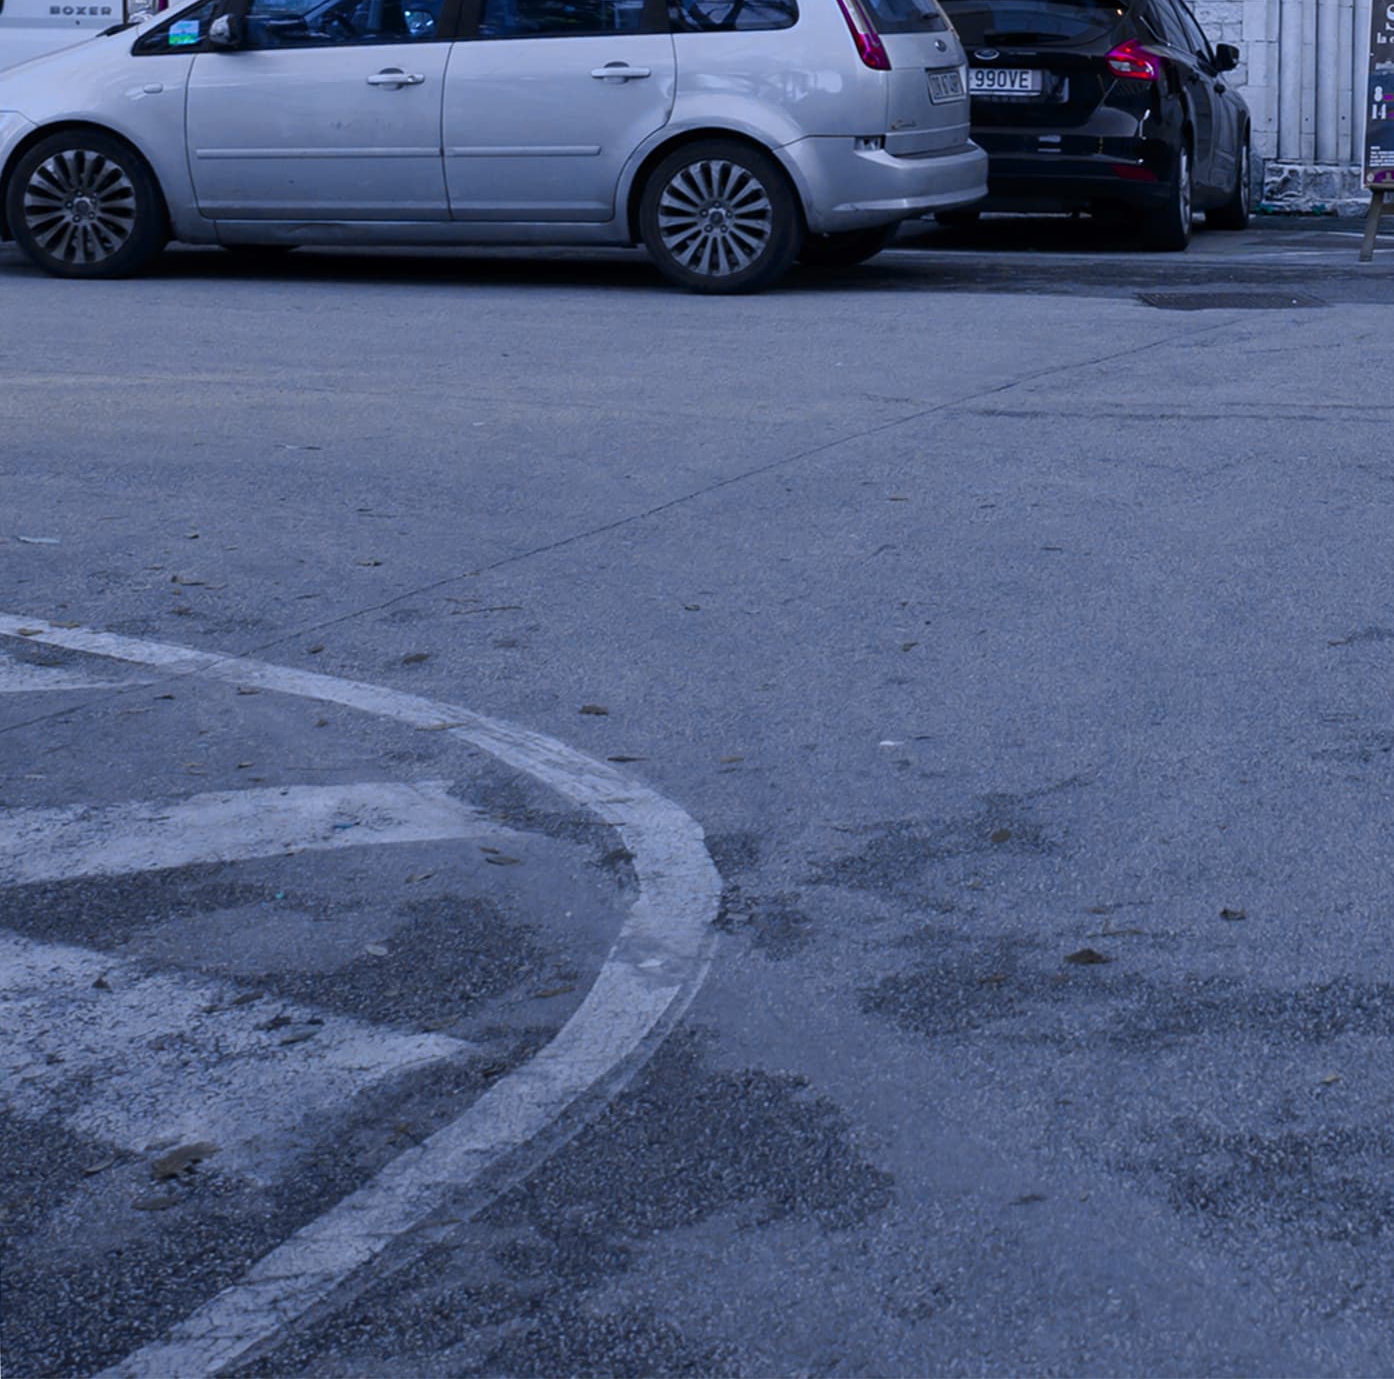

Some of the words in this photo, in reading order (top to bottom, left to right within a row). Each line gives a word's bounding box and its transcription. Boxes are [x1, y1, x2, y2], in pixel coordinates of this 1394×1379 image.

[50, 6, 112, 16] BOXER
[1377, 32, 1387, 44] la
[975, 70, 1029, 89] 990VE
[1374, 86, 1383, 102] 8
[1372, 103, 1387, 120] 14
